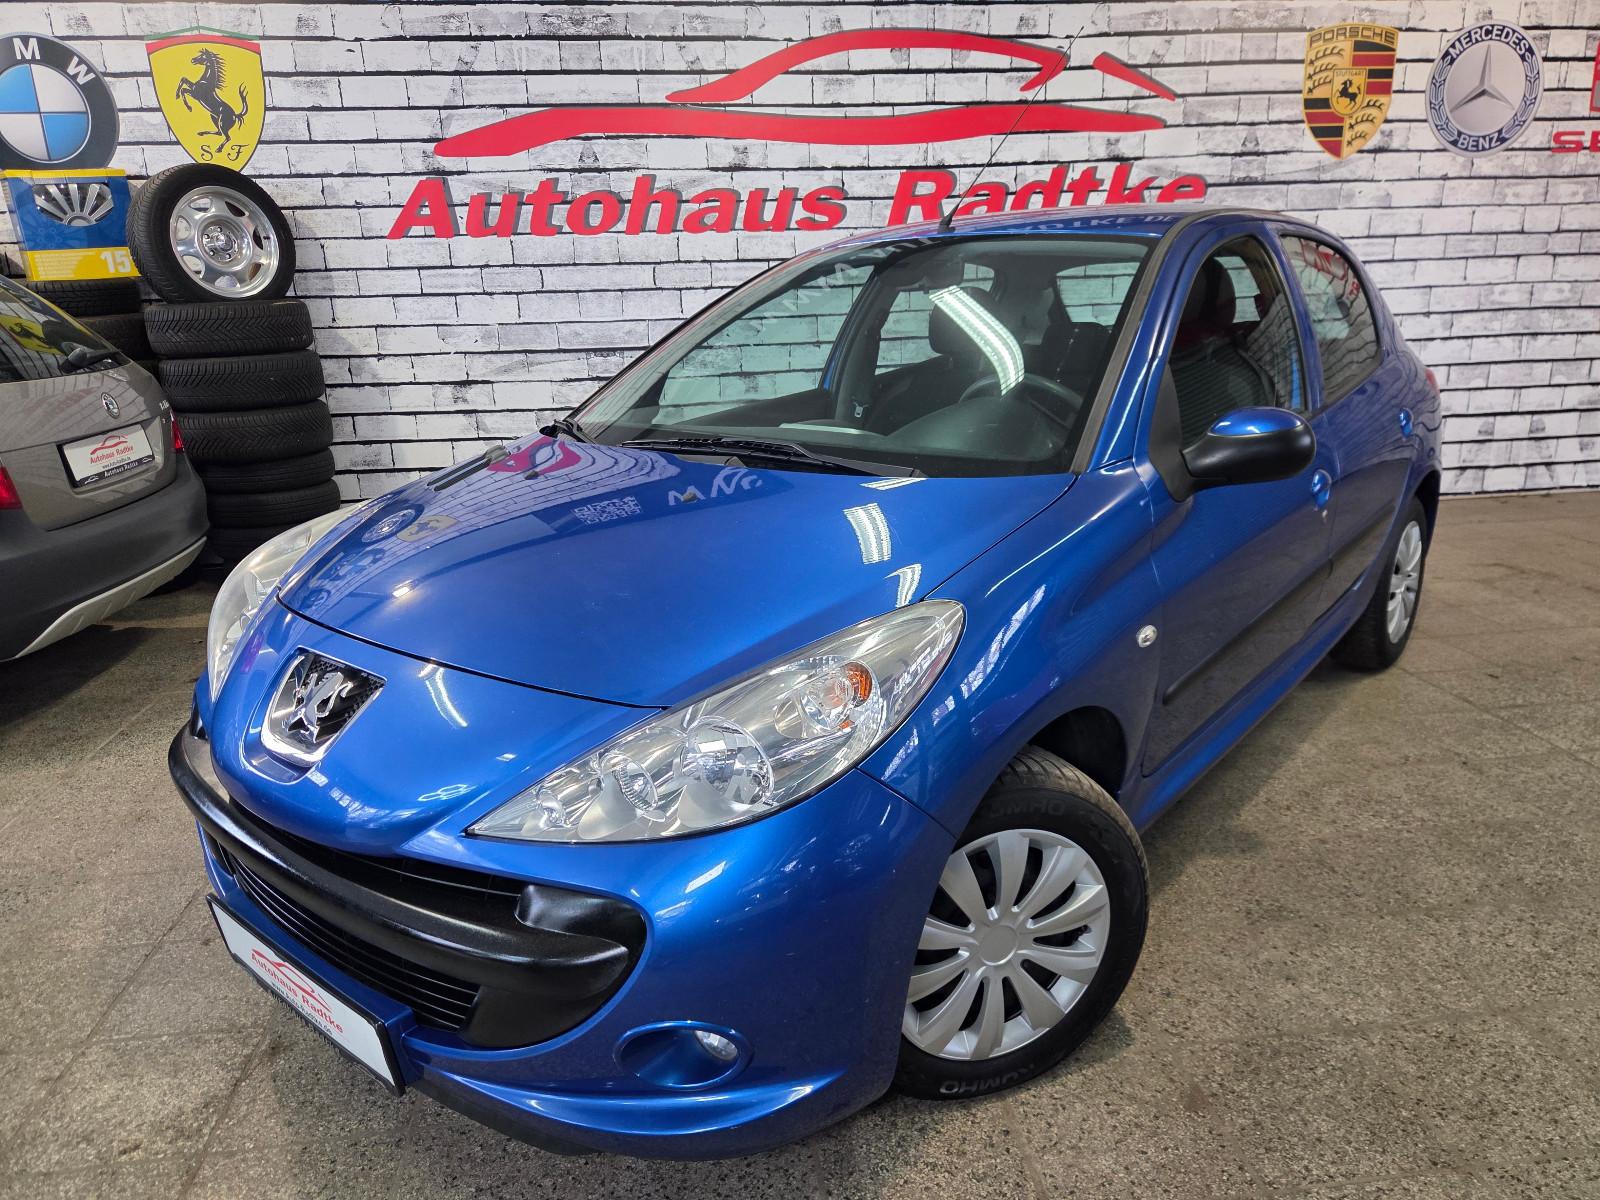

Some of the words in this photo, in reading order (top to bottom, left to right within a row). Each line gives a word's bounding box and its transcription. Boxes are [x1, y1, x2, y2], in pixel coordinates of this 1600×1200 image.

[1309, 26, 1396, 48] PORSCHE
[1448, 25, 1529, 58] MERCEDES
[1458, 131, 1501, 152] BENZ
[387, 174, 848, 240] Autohaus
[886, 162, 1208, 228] Radtke
[100, 249, 132, 273] 15
[90, 449, 115, 465] Autohaus
[251, 953, 298, 998] Autohaus
[301, 994, 343, 1034] Radtke
